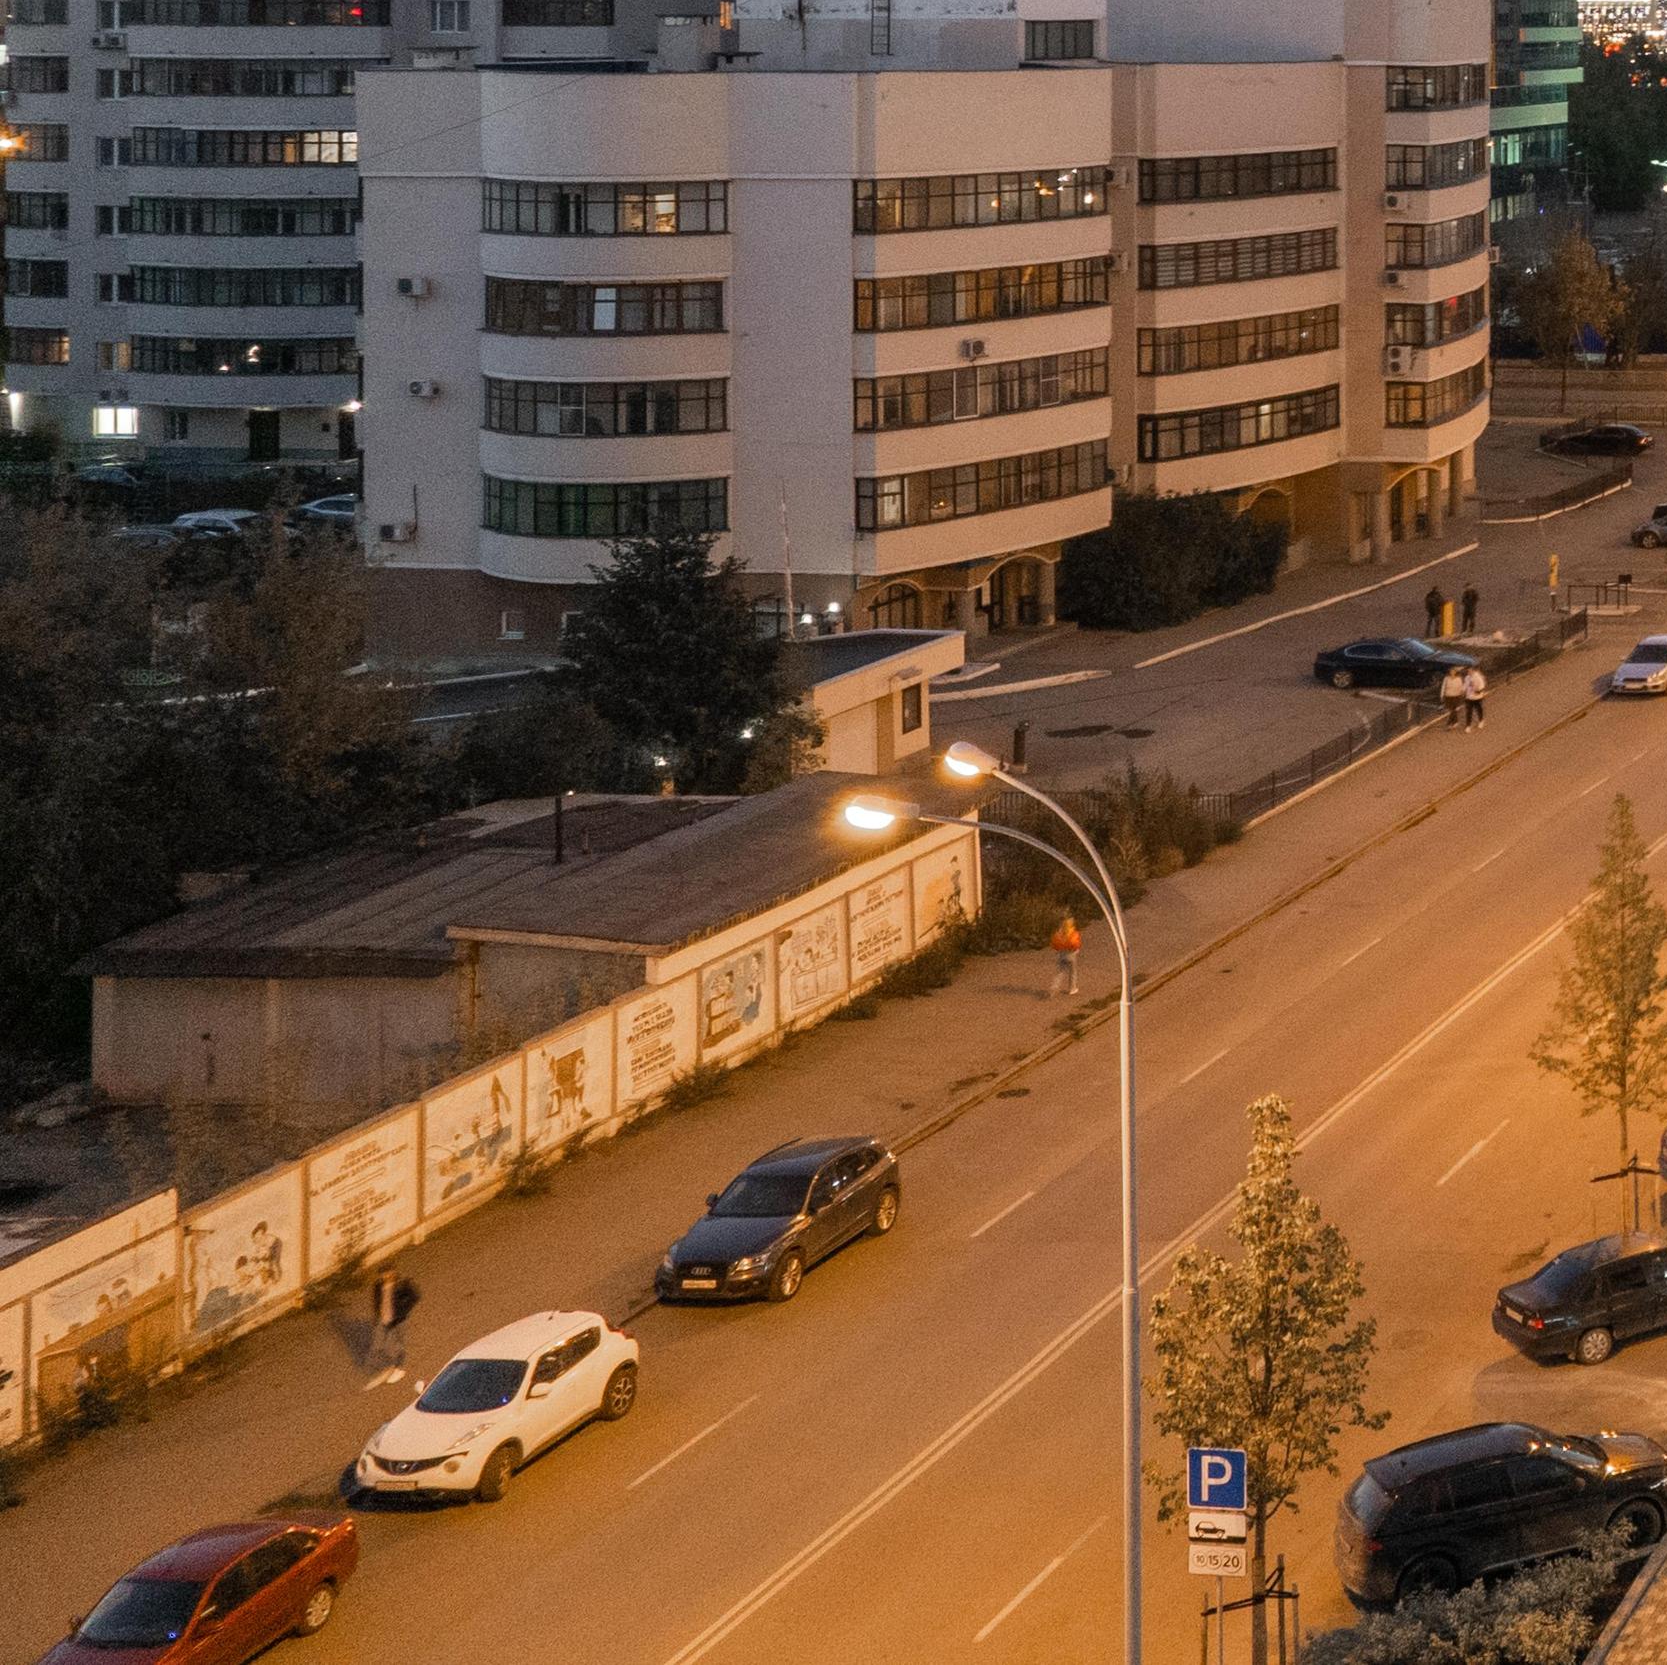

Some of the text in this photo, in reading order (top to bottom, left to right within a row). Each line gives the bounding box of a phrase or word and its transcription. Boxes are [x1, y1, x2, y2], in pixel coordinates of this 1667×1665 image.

[1201, 1455, 1232, 1501] P
[1196, 1555, 1240, 1568] 10 15 20
